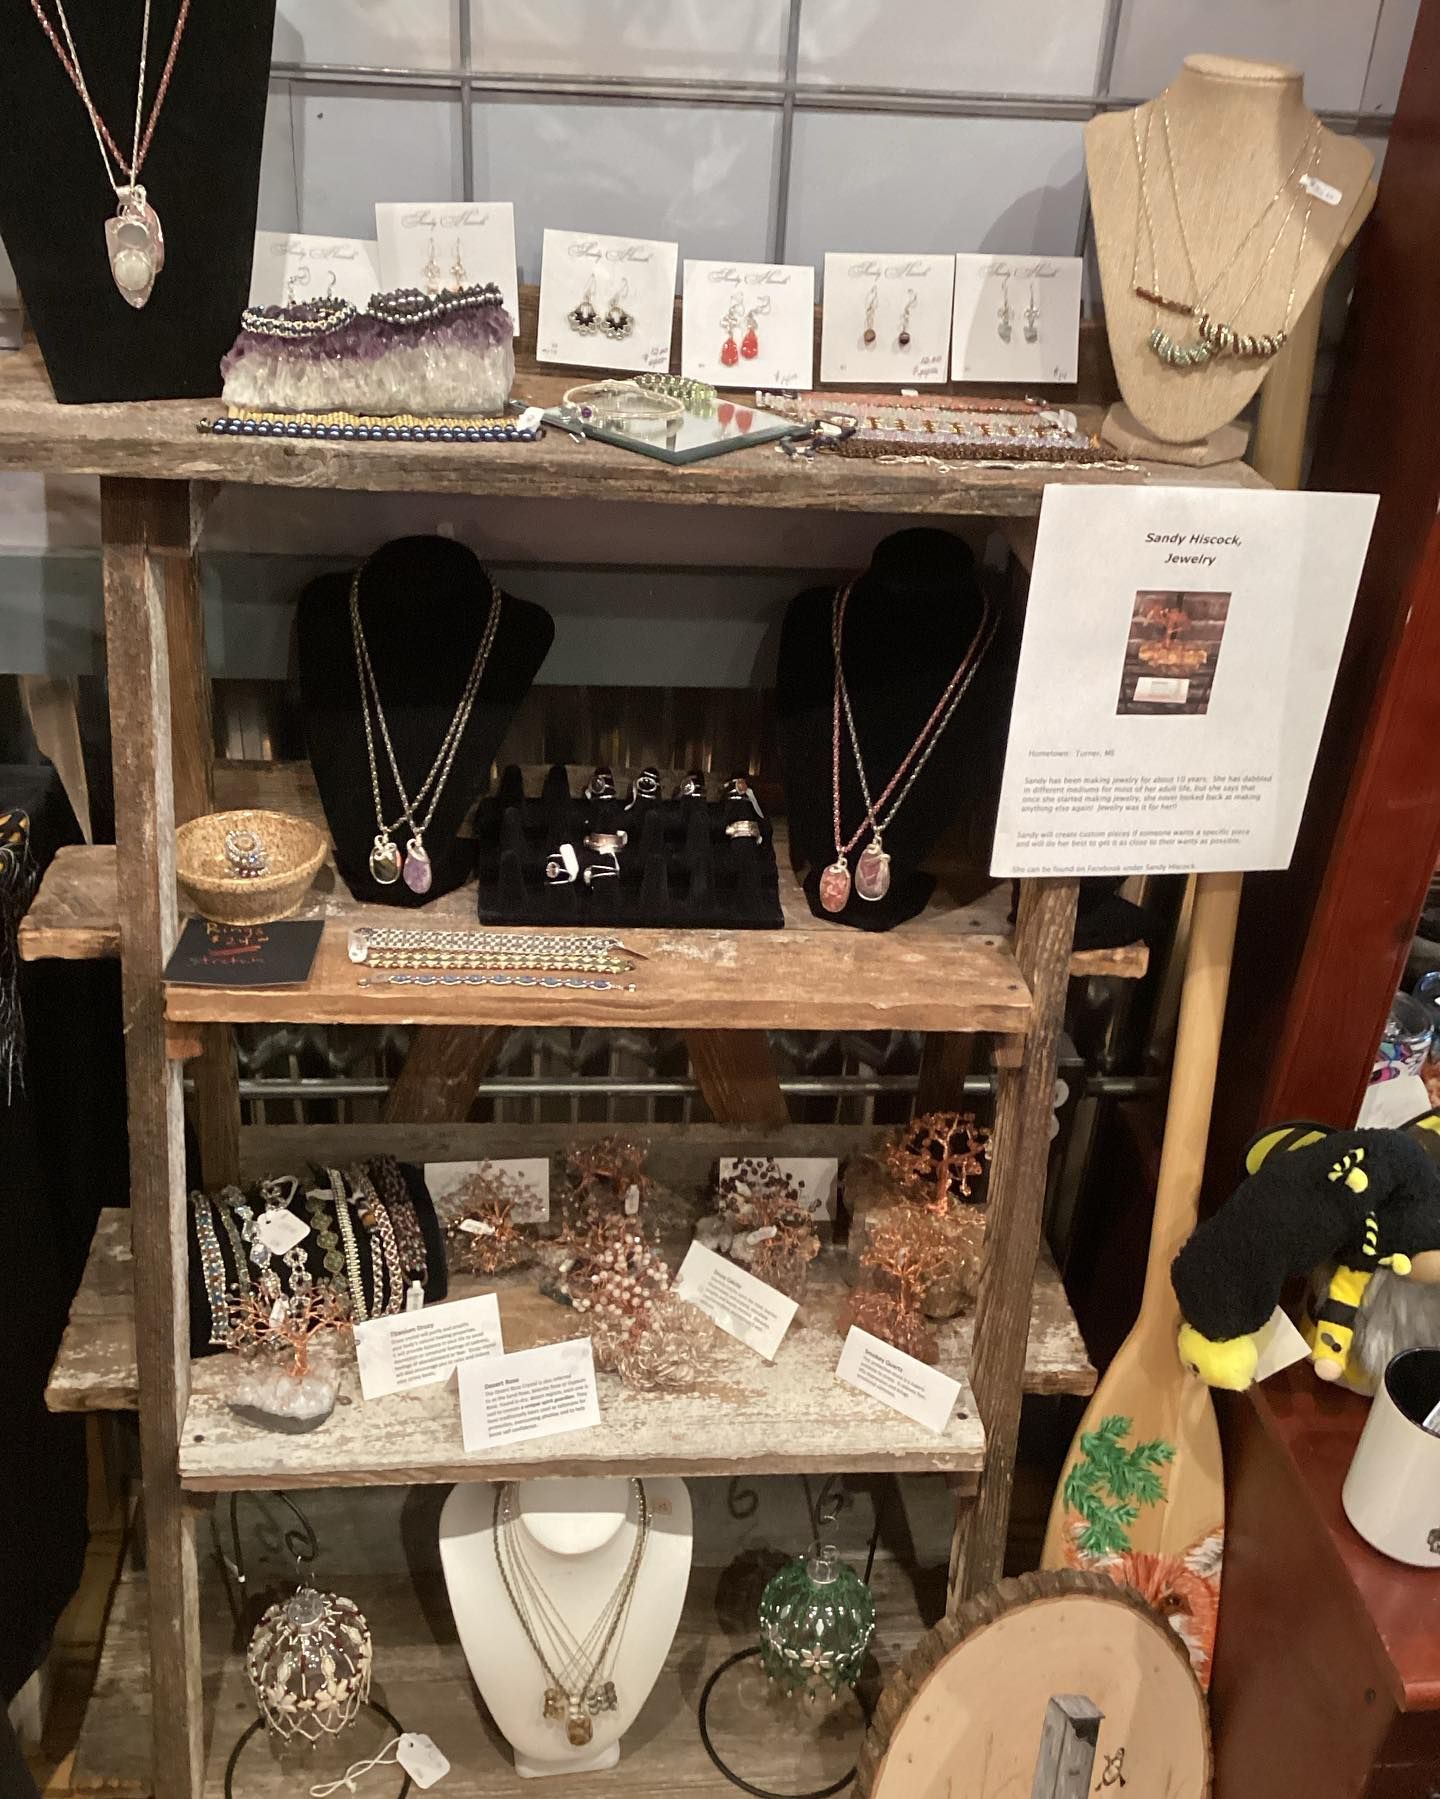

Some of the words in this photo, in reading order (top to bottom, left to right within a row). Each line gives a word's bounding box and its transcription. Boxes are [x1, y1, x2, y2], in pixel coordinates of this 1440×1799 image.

[1145, 532, 1186, 546] Sandy
[1189, 533, 1242, 547] Hiscock,
[1164, 553, 1216, 566] Jewelry
[1024, 777, 1047, 785] Sandy
